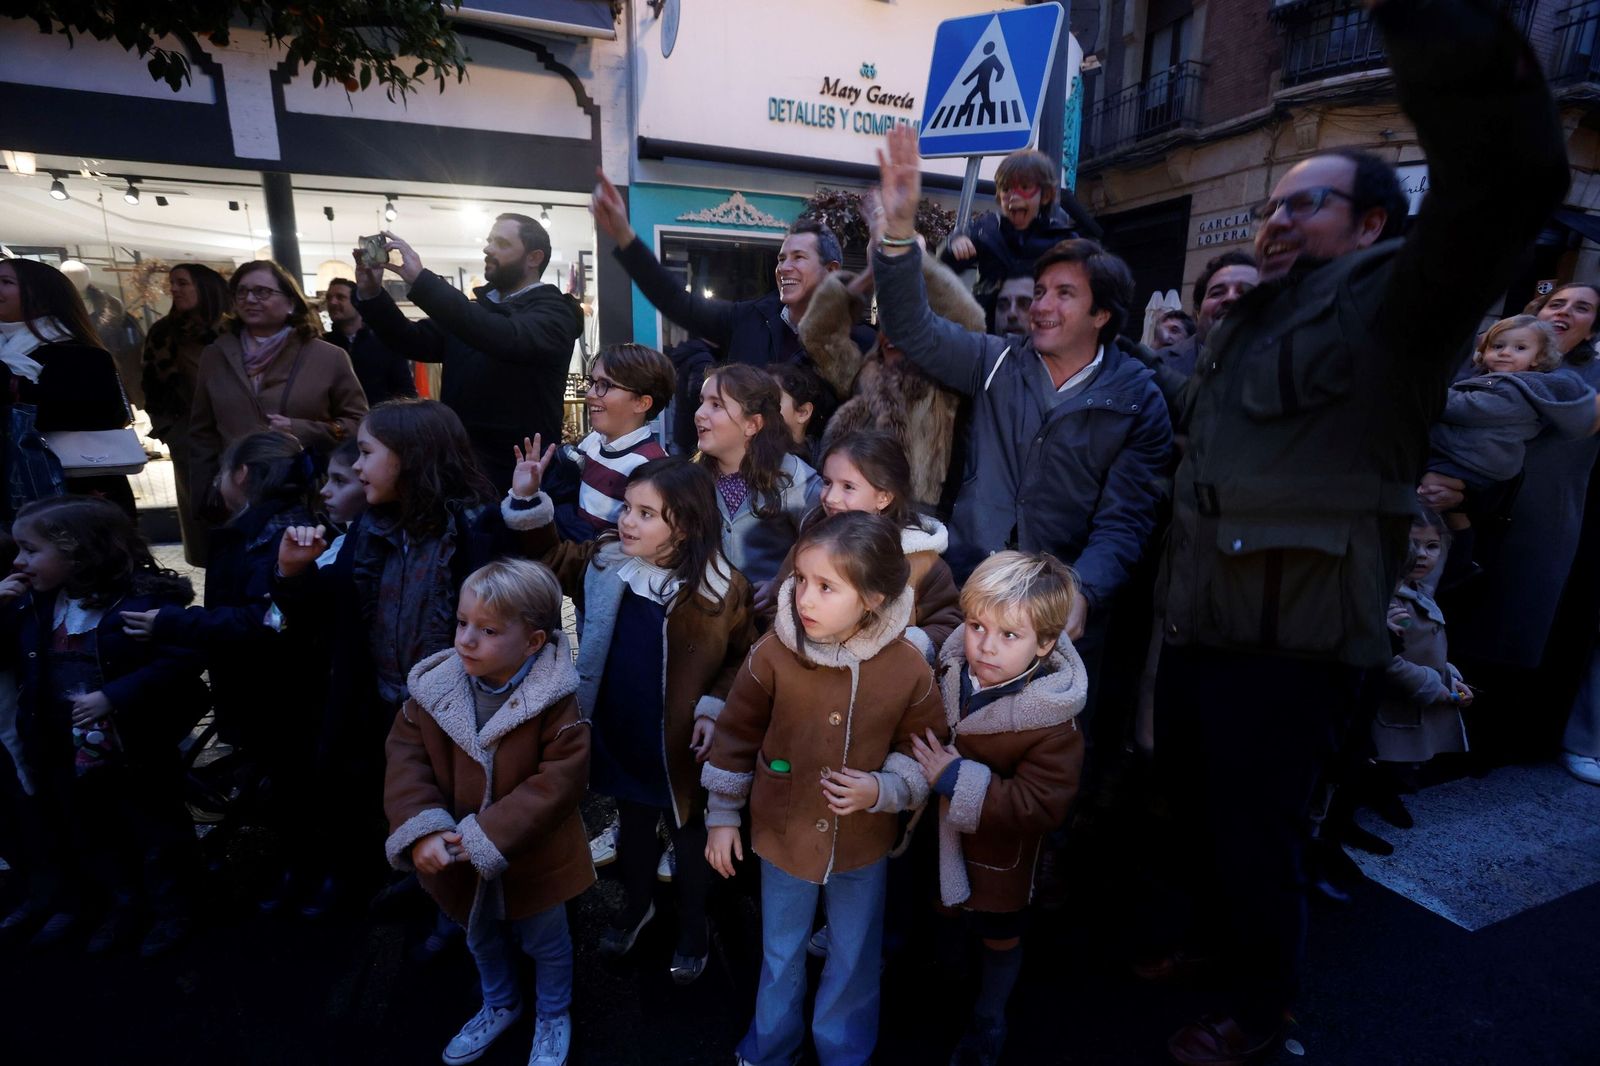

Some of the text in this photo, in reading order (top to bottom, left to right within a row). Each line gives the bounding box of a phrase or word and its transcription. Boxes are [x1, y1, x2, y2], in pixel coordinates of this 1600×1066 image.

[866, 85, 915, 110] García
[768, 97, 835, 129] DETALLES
[840, 107, 850, 130] Y
[1199, 213, 1249, 232] GARCIA
[1198, 229, 1247, 246] LOVERA
